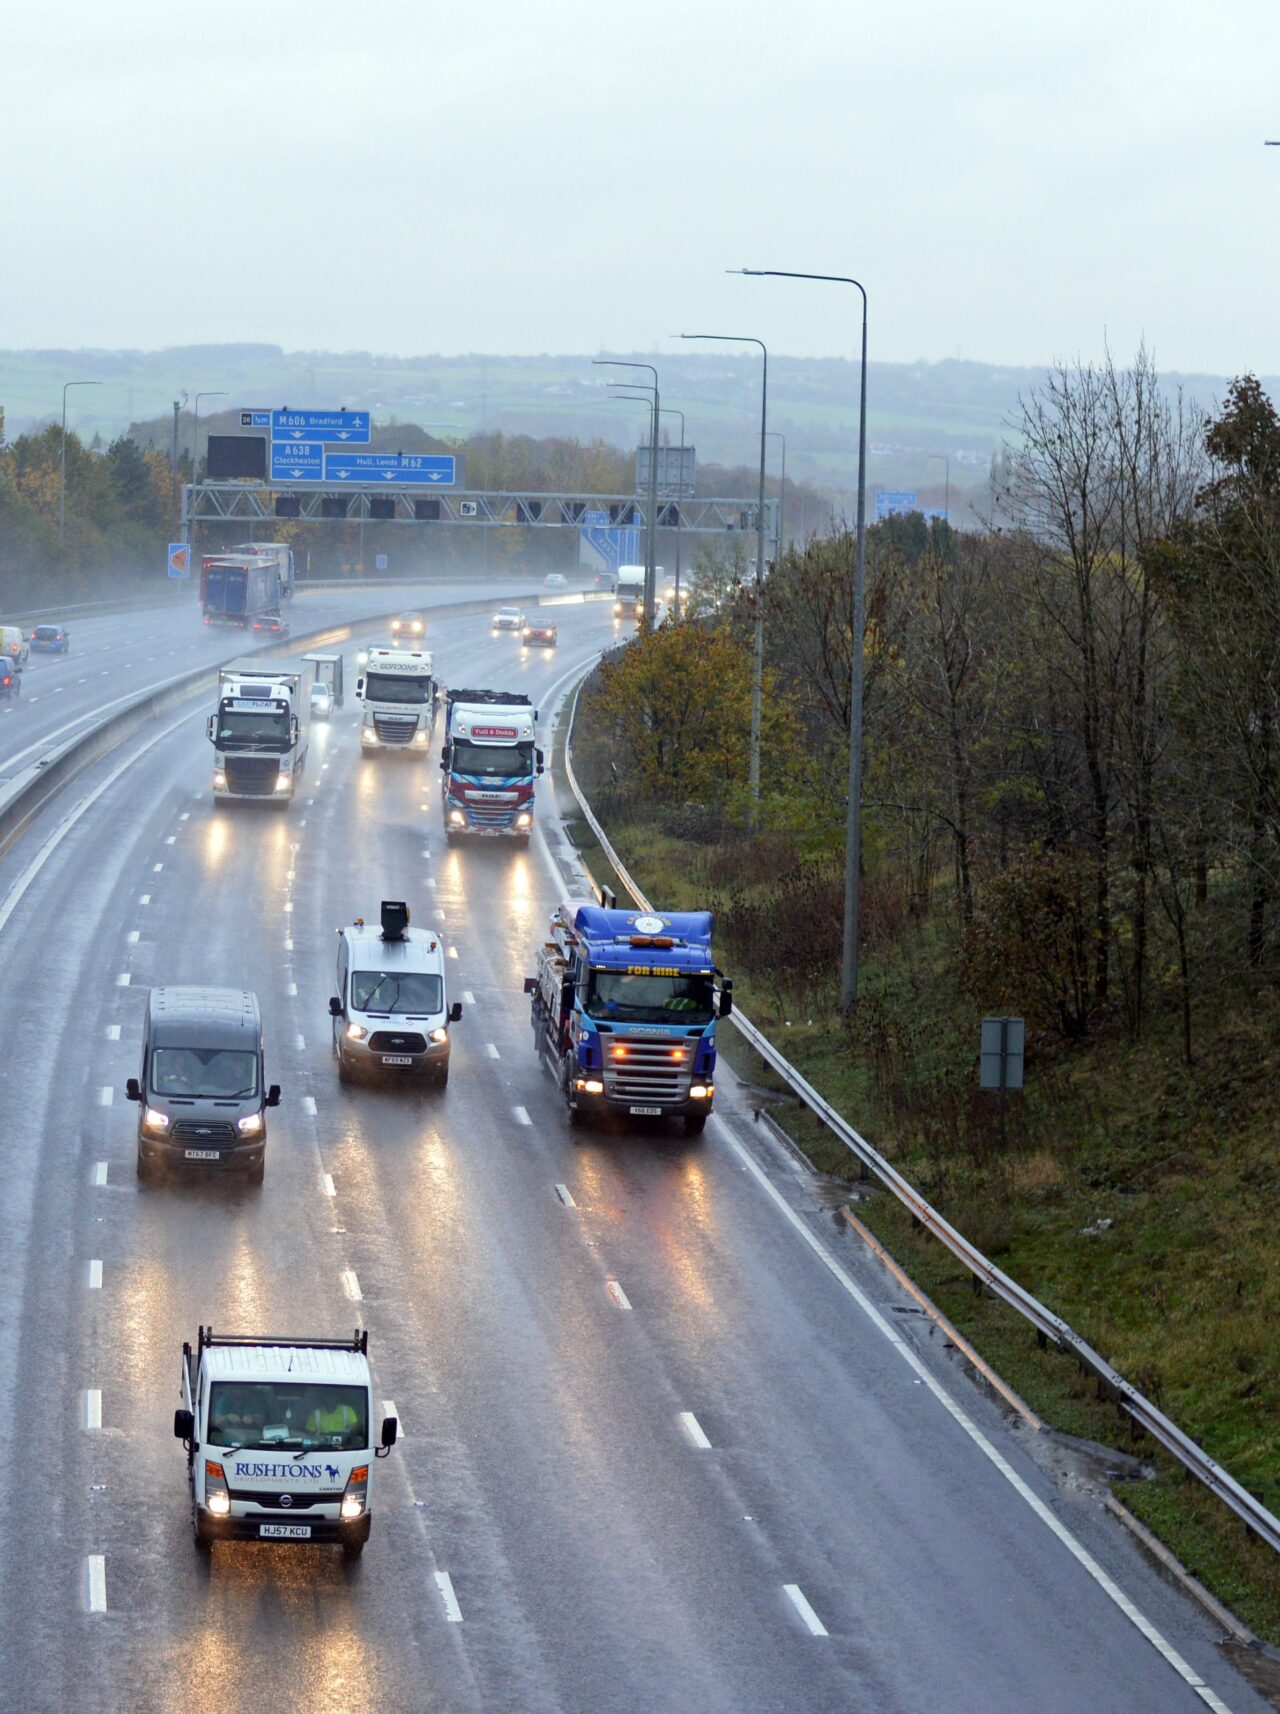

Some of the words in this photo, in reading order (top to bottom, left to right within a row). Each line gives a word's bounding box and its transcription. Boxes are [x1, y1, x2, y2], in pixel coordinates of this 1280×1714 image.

[309, 417, 343, 425] Bradford
[274, 456, 320, 465] Cleckheaton
[376, 458, 398, 466] Leeds
[627, 965, 650, 975] FOR
[652, 966, 680, 977] HIRE
[629, 1027, 671, 1036] SCANIA
[235, 1462, 322, 1478] RUSHTONS
[264, 1526, 287, 1535] HJ57
[289, 1527, 308, 1536] KCU
